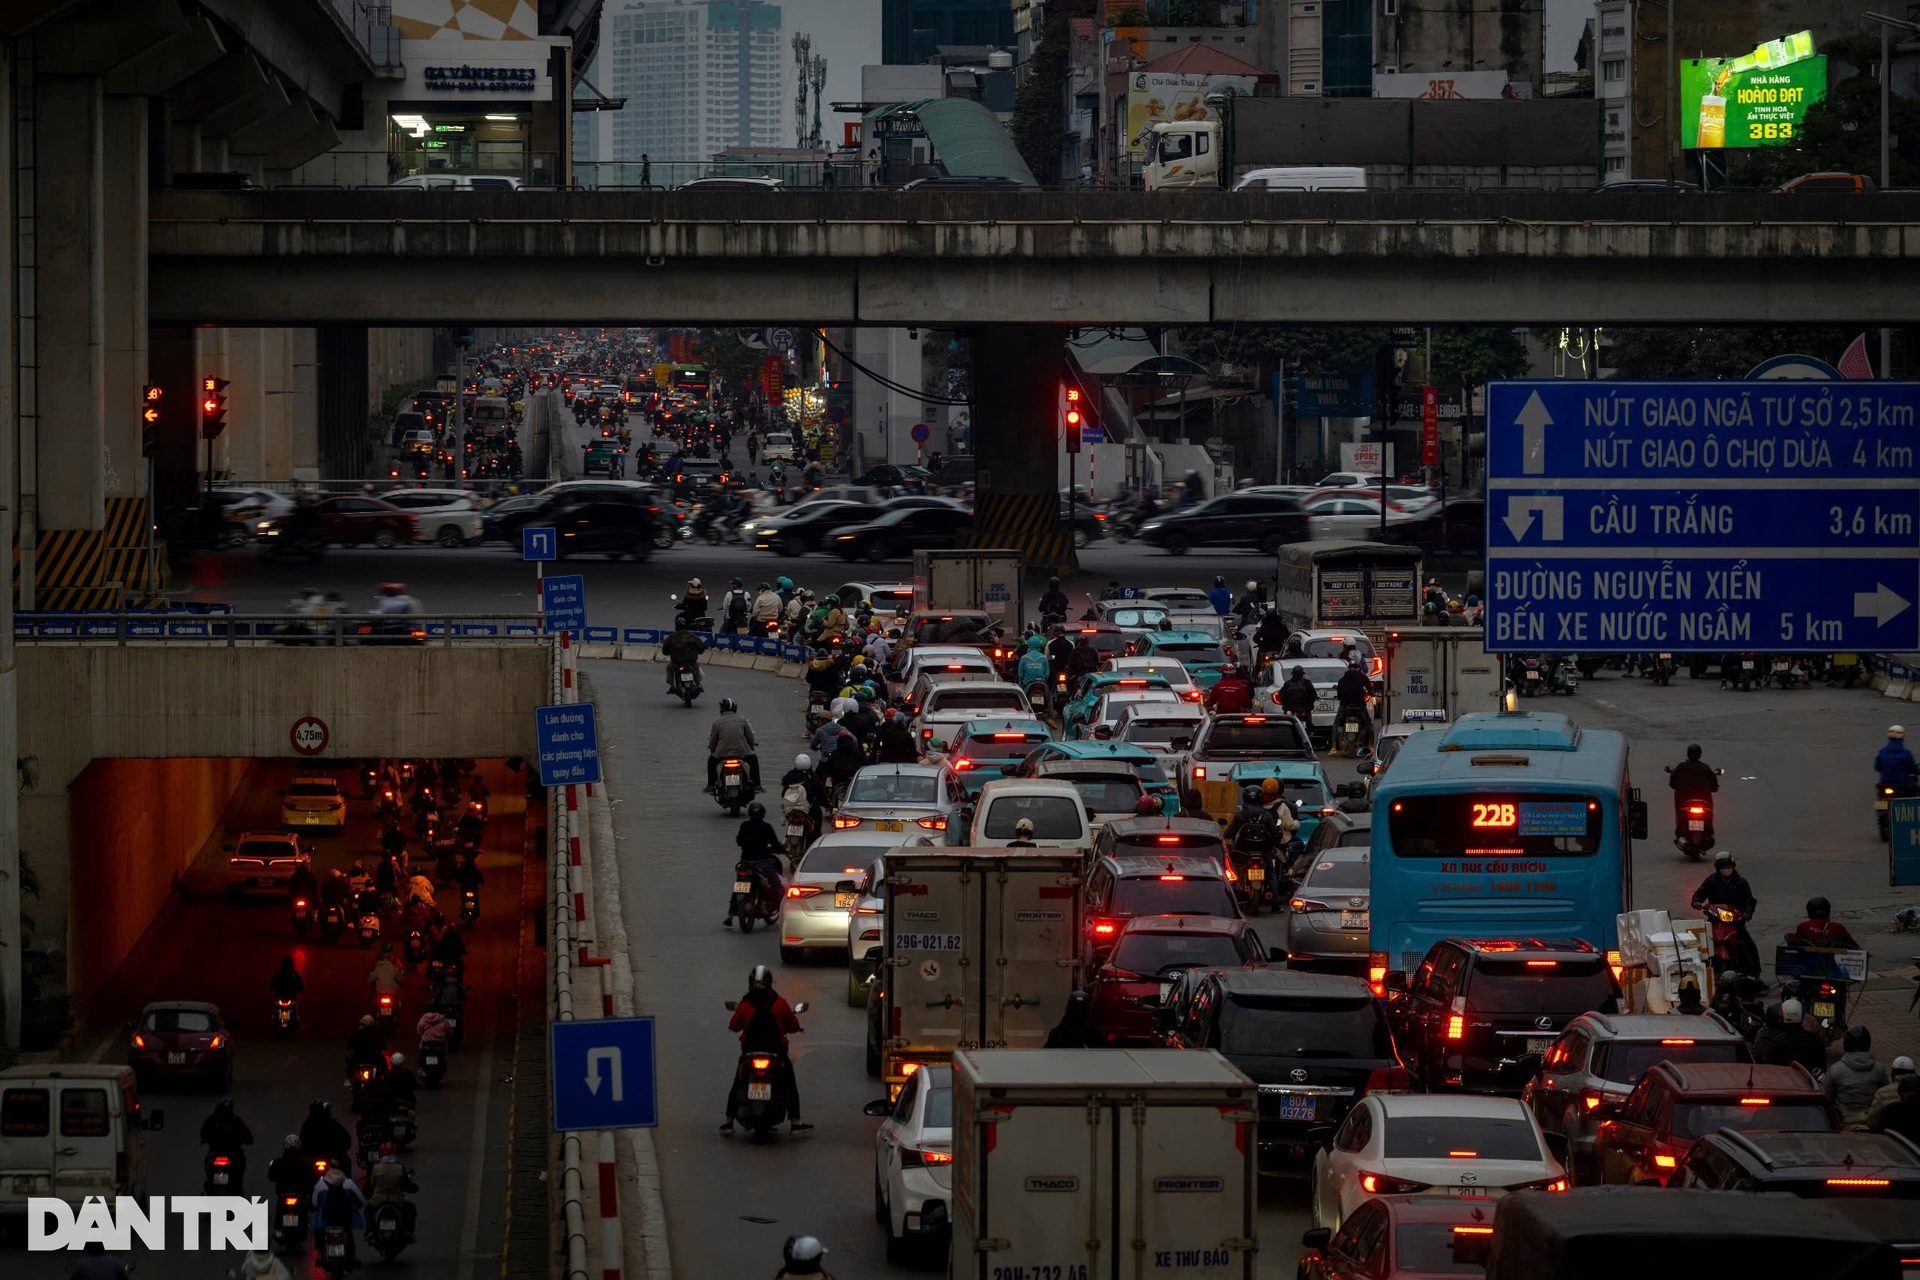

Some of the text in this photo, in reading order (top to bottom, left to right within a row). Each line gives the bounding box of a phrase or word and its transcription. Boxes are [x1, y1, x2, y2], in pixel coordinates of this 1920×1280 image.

[1750, 74, 1791, 84] NHÀ HÀNG
[1428, 80, 1454, 99] 357
[1737, 86, 1804, 107] HOÀNG ĐẠT
[1750, 122, 1792, 140] 363
[206, 380, 214, 390] 38
[1068, 390, 1078, 400] 38
[1584, 387, 1914, 430] NÚT GIAO NGÃ TƯ SỞ 2,5 km
[1354, 452, 1379, 460] SPORT
[1584, 431, 1913, 474] NÚT GIAO Ô CHỢ DỪA 4 km
[1590, 494, 1912, 538] CẦU TRẮNG 3,6 km
[548, 582, 577, 591] Làn đường
[1495, 560, 1761, 600] ĐƯỜNG NGUYỄN XIỂN
[990, 584, 1005, 592] 29C
[1124, 588, 1134, 598] G7
[553, 596, 566, 604] dành
[985, 593, 1011, 601] 833.40
[555, 608, 574, 617] phương
[568, 618, 577, 626] đầu
[1497, 602, 1843, 641] BẾN XE NƯỚC NGẦM 5 km
[1411, 676, 1423, 684] 90C
[545, 712, 584, 725] Làn đường
[297, 730, 323, 742] 4,75m
[552, 730, 584, 742] dành cho
[542, 748, 597, 762] các phương tiện
[552, 764, 585, 780] quay đầu
[1473, 804, 1516, 826] 22B
[1461, 862, 1482, 873] BUS
[1485, 858, 1510, 873] CẦU
[896, 934, 960, 950] 29G-021.62
[1289, 1096, 1307, 1107] 80A
[1282, 1106, 1314, 1119] 037.76
[1030, 1180, 1220, 1189] THACO FRONTIER
[1156, 1248, 1230, 1268] XE THƯ BÁO
[994, 1264, 1088, 1280] 29H-73246
